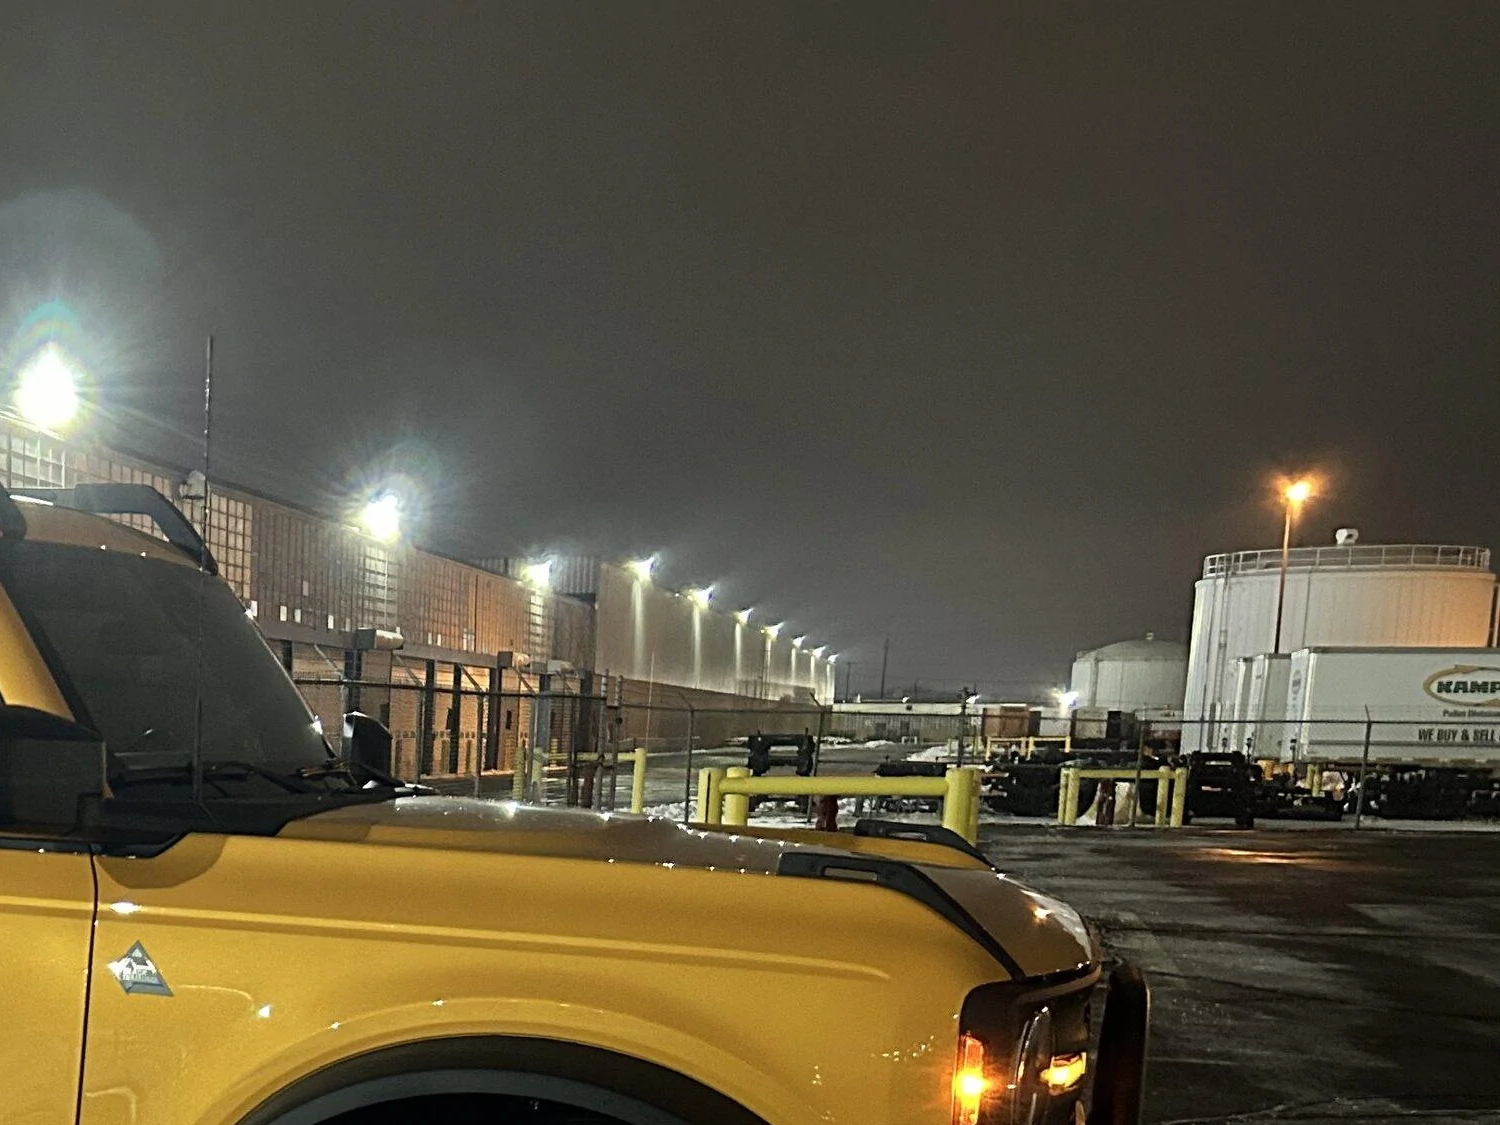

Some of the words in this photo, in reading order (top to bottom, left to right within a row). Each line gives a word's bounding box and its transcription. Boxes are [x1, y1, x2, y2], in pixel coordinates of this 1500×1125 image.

[1437, 728, 1458, 741] BUY
[1461, 728, 1470, 741] &
[1473, 728, 1496, 741] SELL
